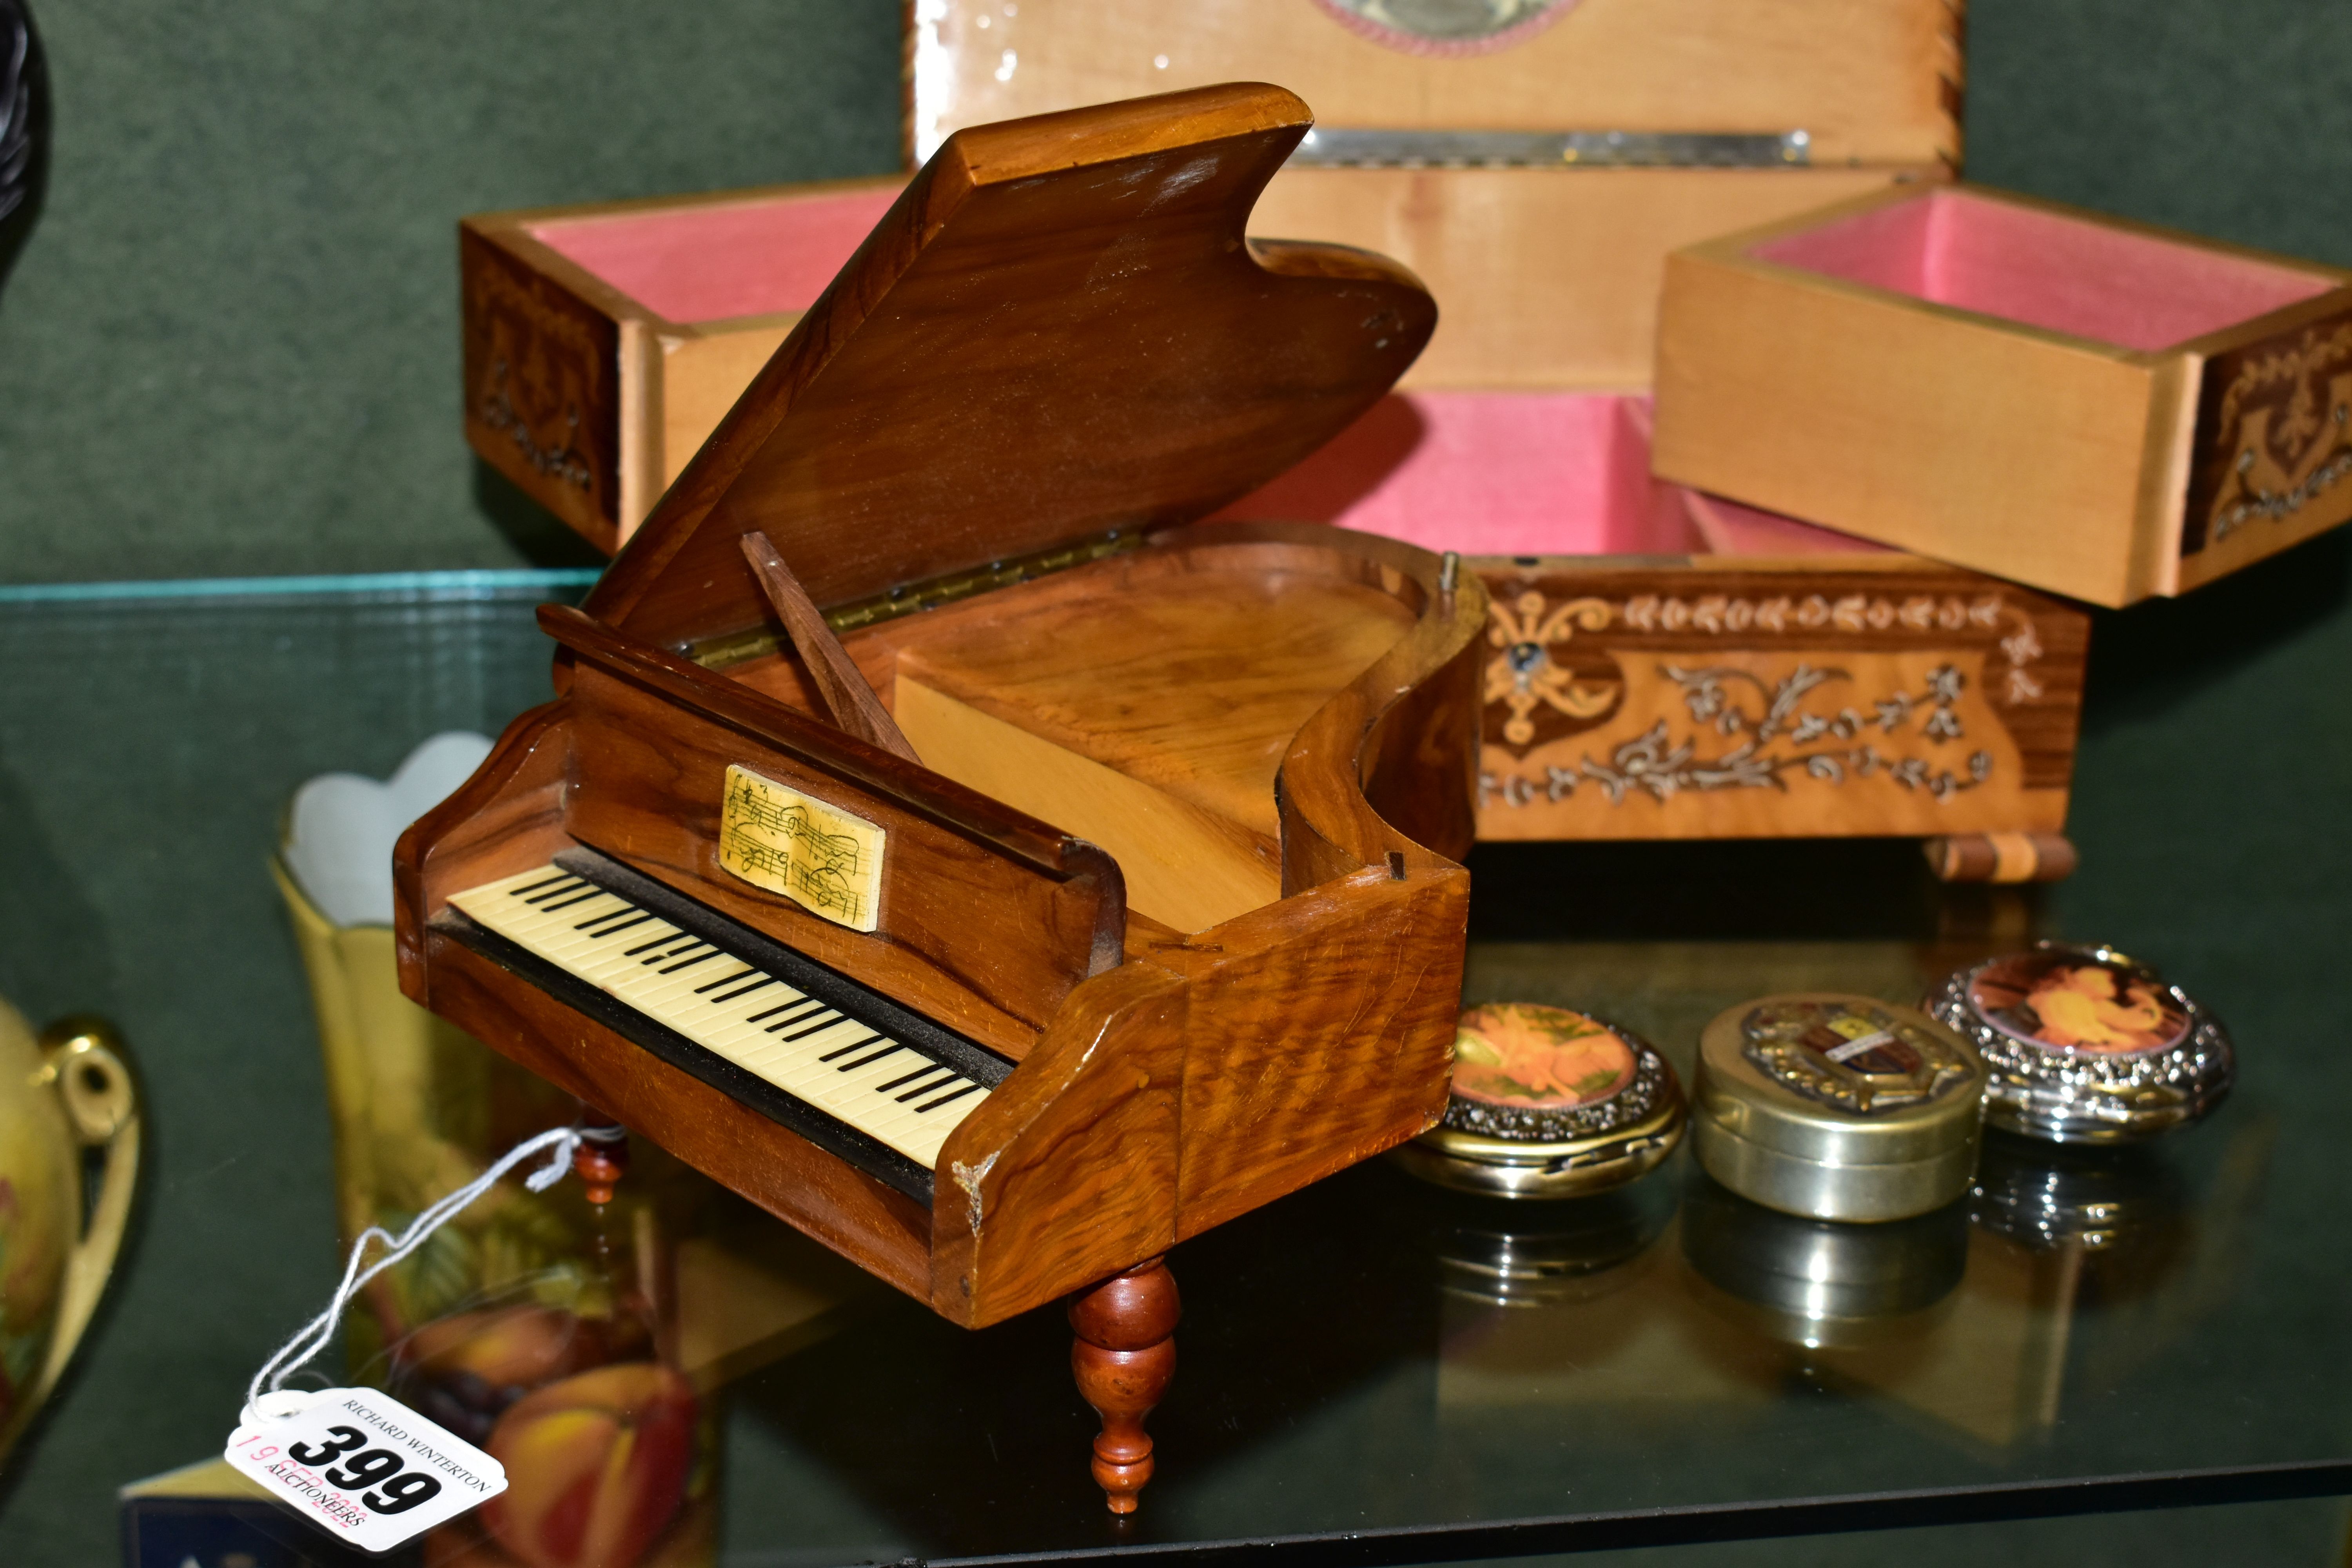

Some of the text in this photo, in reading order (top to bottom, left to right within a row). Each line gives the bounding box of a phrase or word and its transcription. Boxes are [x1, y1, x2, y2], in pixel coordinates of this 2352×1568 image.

[289, 1425, 442, 1515] 399
[343, 1399, 492, 1492] RICHARD WINTERTON
[264, 1463, 365, 1526] AUCTIONEERS
